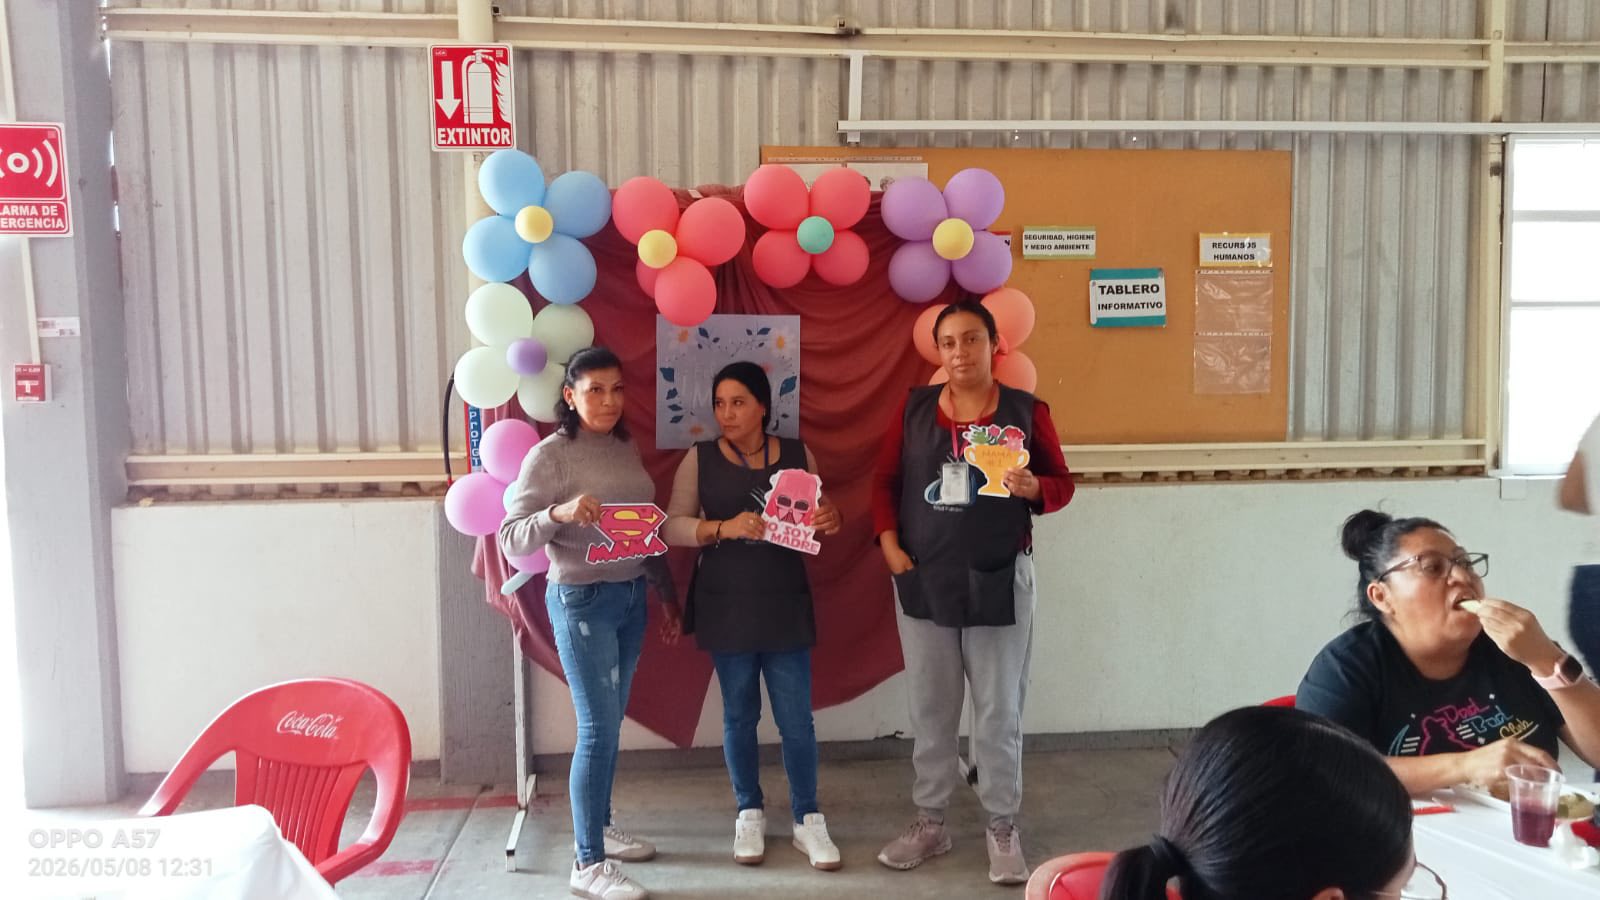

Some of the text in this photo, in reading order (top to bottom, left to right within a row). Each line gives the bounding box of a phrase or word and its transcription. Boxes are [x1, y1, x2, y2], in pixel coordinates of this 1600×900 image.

[437, 127, 511, 145] EXTINTOR
[0, 205, 59, 217] ARMA DE
[1213, 253, 1255, 261] HUMANOS
[1098, 284, 1160, 295] TABLERO
[1097, 301, 1163, 311] INFORMATIVO
[770, 532, 820, 553] MADRE
[1433, 697, 1490, 723] Dad
